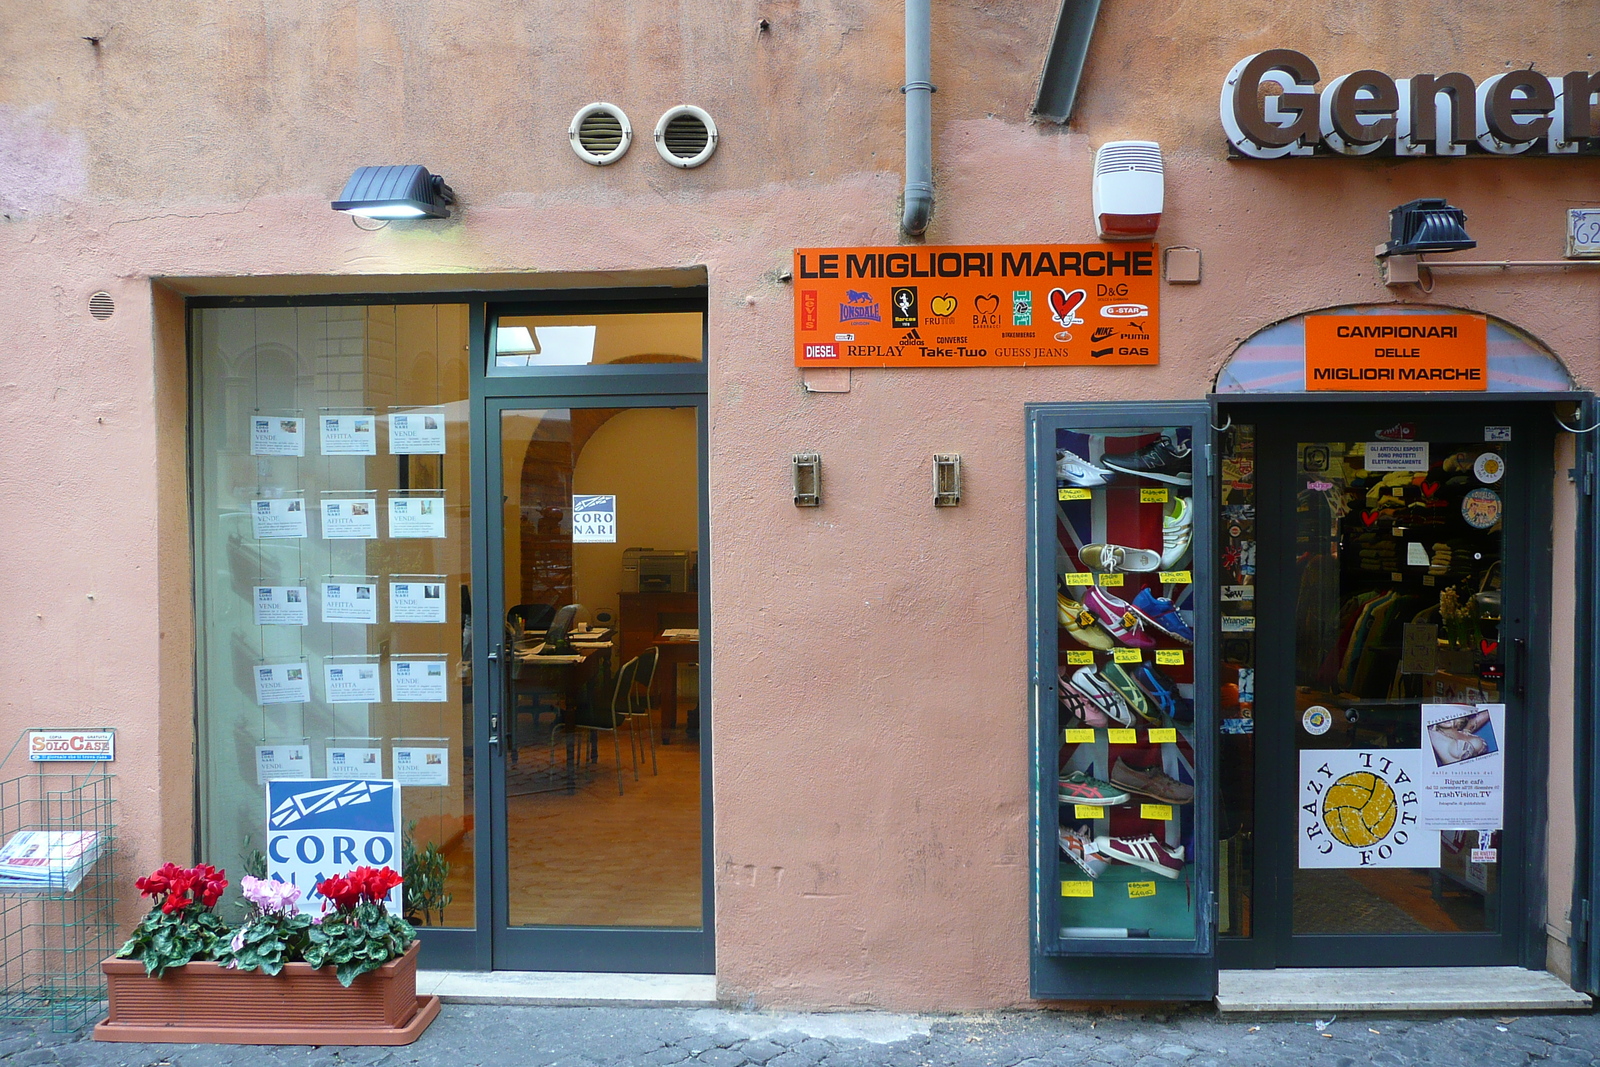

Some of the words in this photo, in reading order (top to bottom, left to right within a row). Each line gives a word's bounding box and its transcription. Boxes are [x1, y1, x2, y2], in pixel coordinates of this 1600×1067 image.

[800, 255, 838, 279] LE
[846, 253, 995, 278] MIGLIORI
[1002, 252, 1153, 277] MARCHE
[1097, 284, 1128, 297] D&G
[839, 303, 882, 323] LONSDALE
[973, 315, 1001, 325] BACI
[1095, 327, 1114, 336] NIKE
[1336, 326, 1458, 339] CAMPIONARI
[937, 336, 968, 344] CONVERSE
[806, 346, 837, 357] DIESEL
[847, 345, 906, 357] REPLAY
[995, 348, 1031, 357] GUESS
[1034, 348, 1069, 358] JEANS
[1118, 347, 1149, 355] GAS
[1374, 348, 1420, 358] DELLE
[1313, 368, 1395, 381] MIGLIORI
[1398, 368, 1481, 381] MARCHE
[574, 513, 613, 523] CORO
[574, 525, 613, 534] NARI
[1222, 617, 1254, 626] Wrangler
[1302, 762, 1334, 855] CRAZY
[1359, 752, 1418, 866] FOOTBALL
[268, 834, 393, 865] CORO
